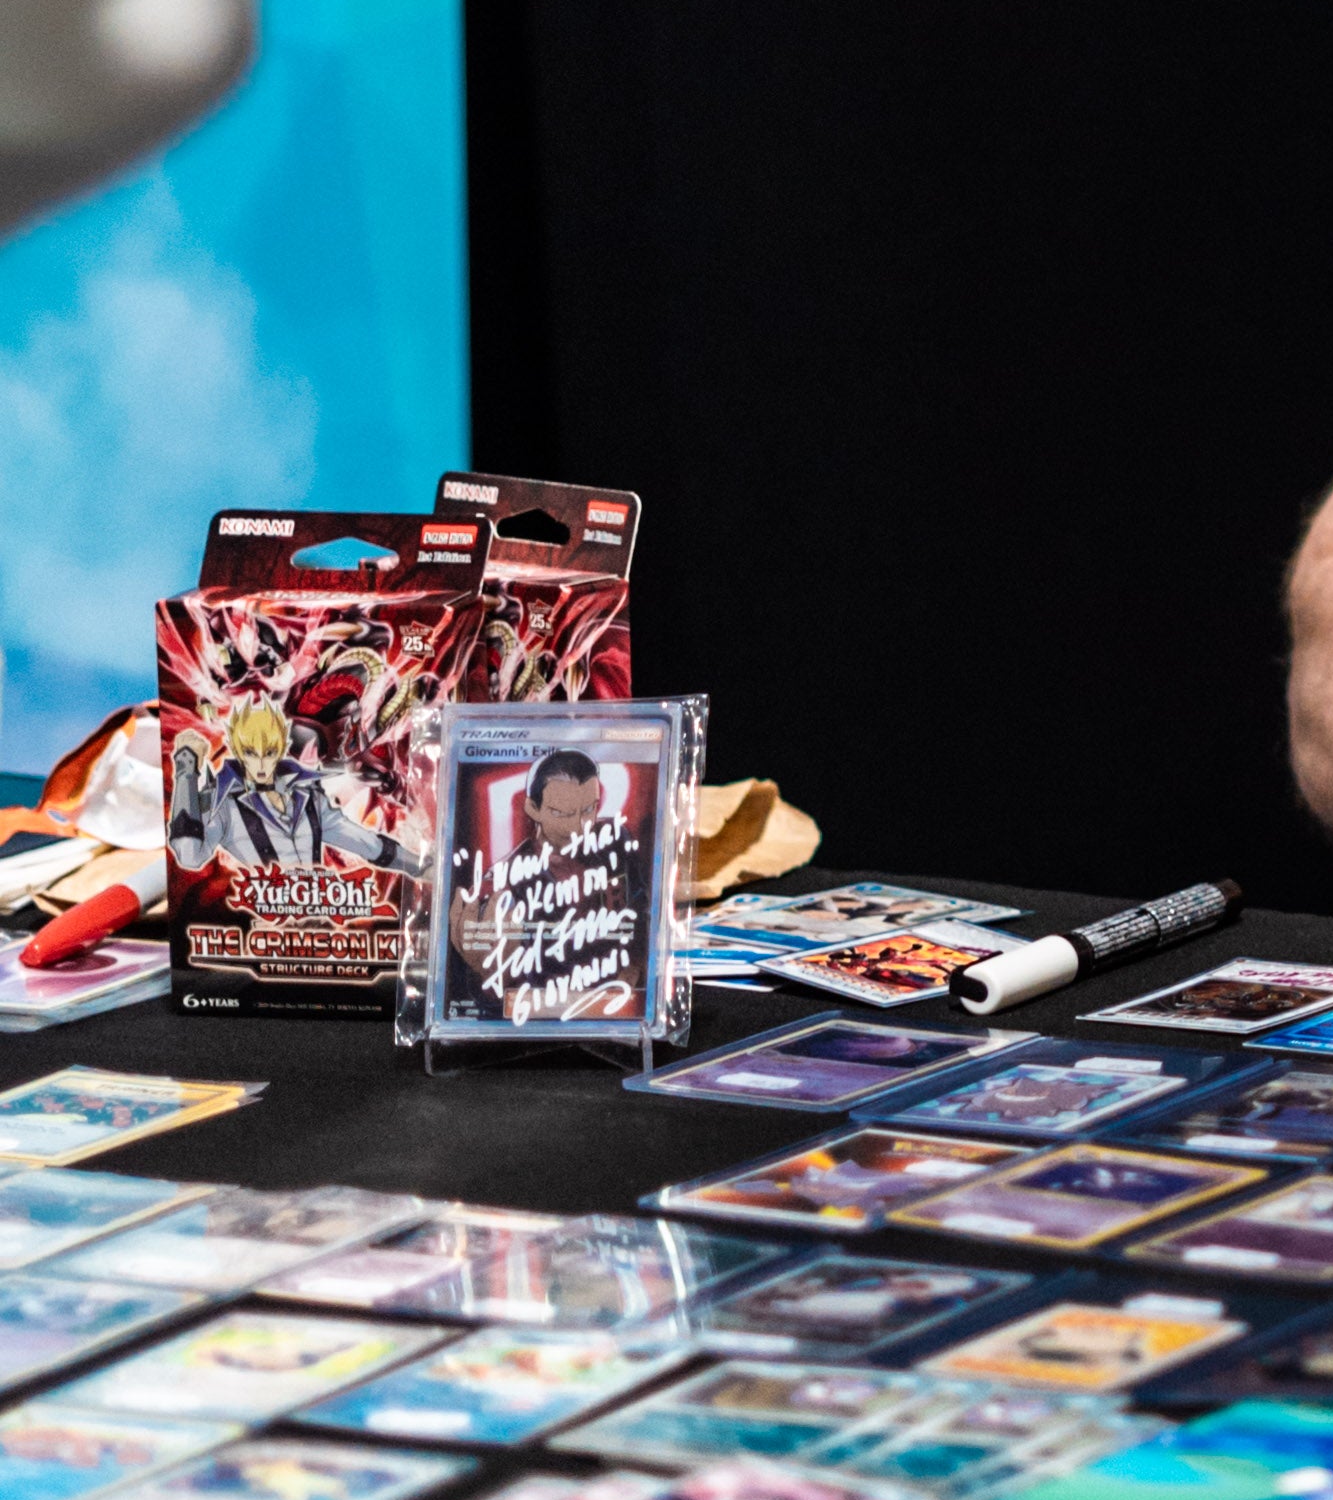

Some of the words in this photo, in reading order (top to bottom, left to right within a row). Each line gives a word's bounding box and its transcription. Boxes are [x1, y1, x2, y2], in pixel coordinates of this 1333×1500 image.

[218, 517, 295, 537] KONAMI
[459, 730, 530, 740] TRAINER
[464, 745, 529, 759] Giovanni's
[560, 812, 628, 858] that
[255, 904, 304, 916] TRADING
[305, 905, 338, 916] CARD
[338, 905, 373, 917] GAME
[189, 927, 242, 957] THE
[249, 930, 371, 960] CRIMSON
[259, 962, 334, 977] STRUCTURE
[336, 965, 370, 978] DECK
[207, 997, 240, 1009] YEARS
